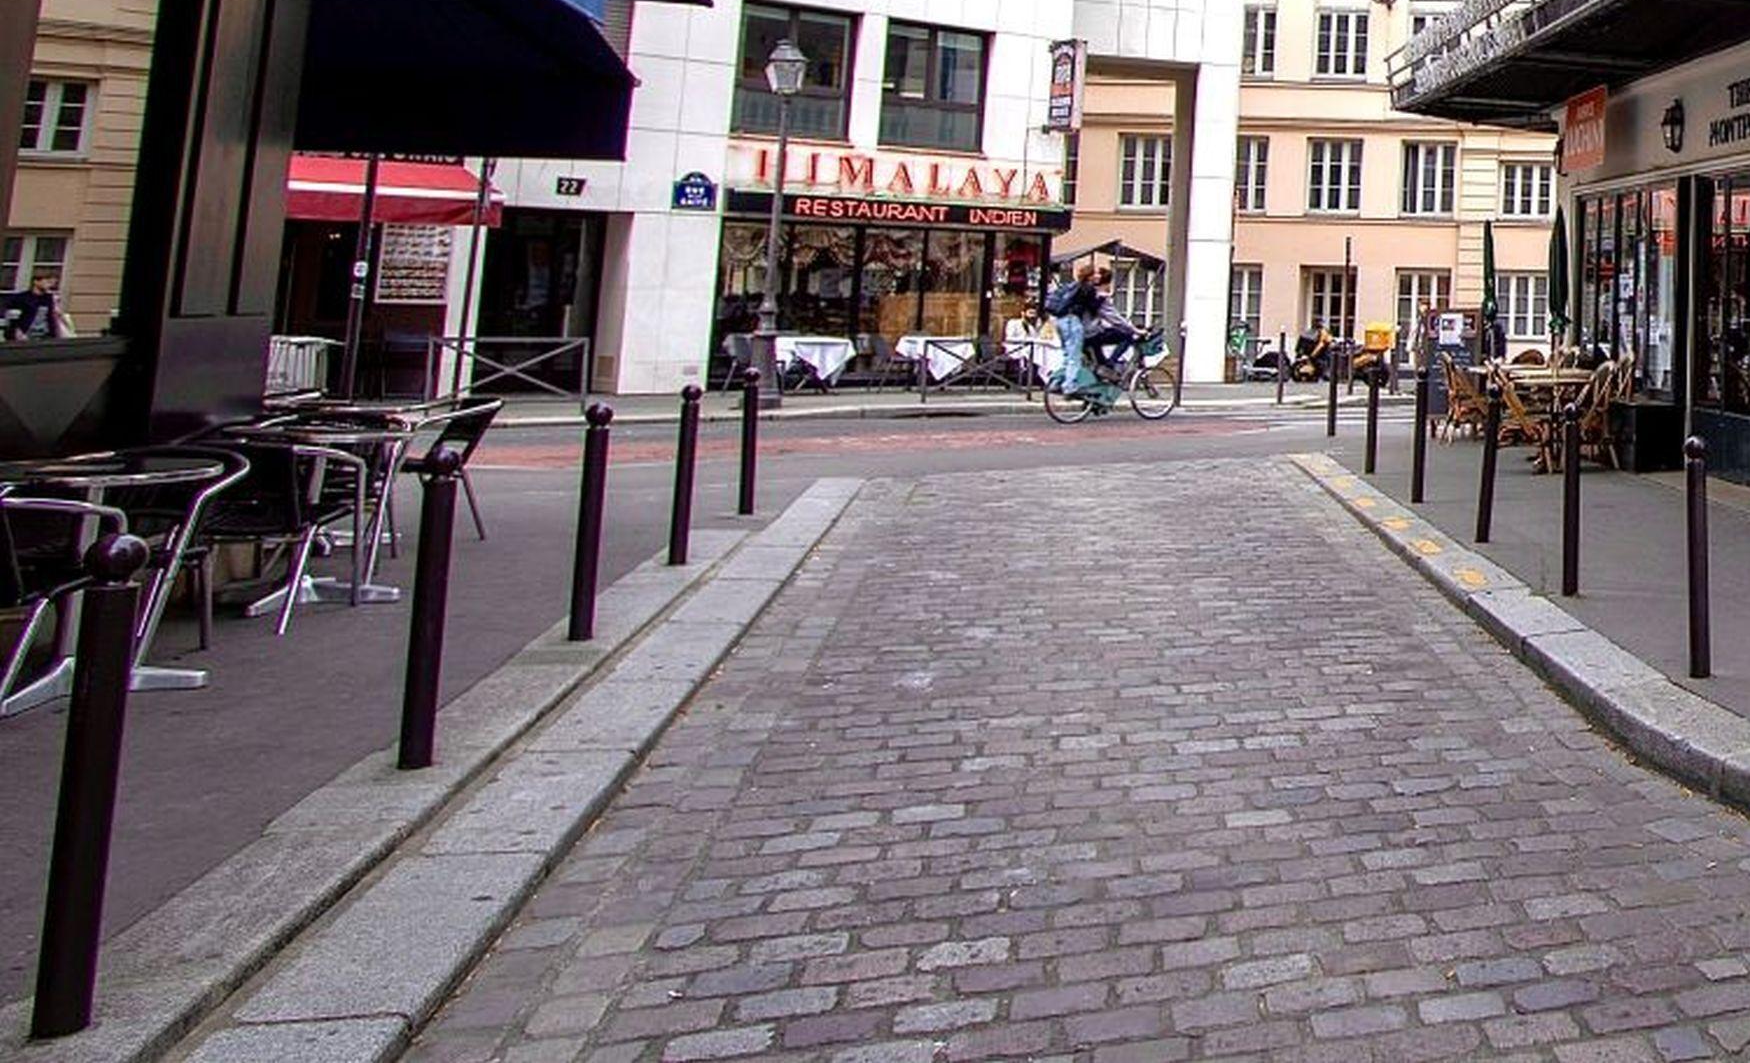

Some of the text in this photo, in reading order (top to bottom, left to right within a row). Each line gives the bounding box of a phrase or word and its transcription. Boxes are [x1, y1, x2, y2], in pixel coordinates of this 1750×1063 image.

[559, 179, 580, 193] 22
[795, 198, 1038, 226] RESTAURANT INDIEN
